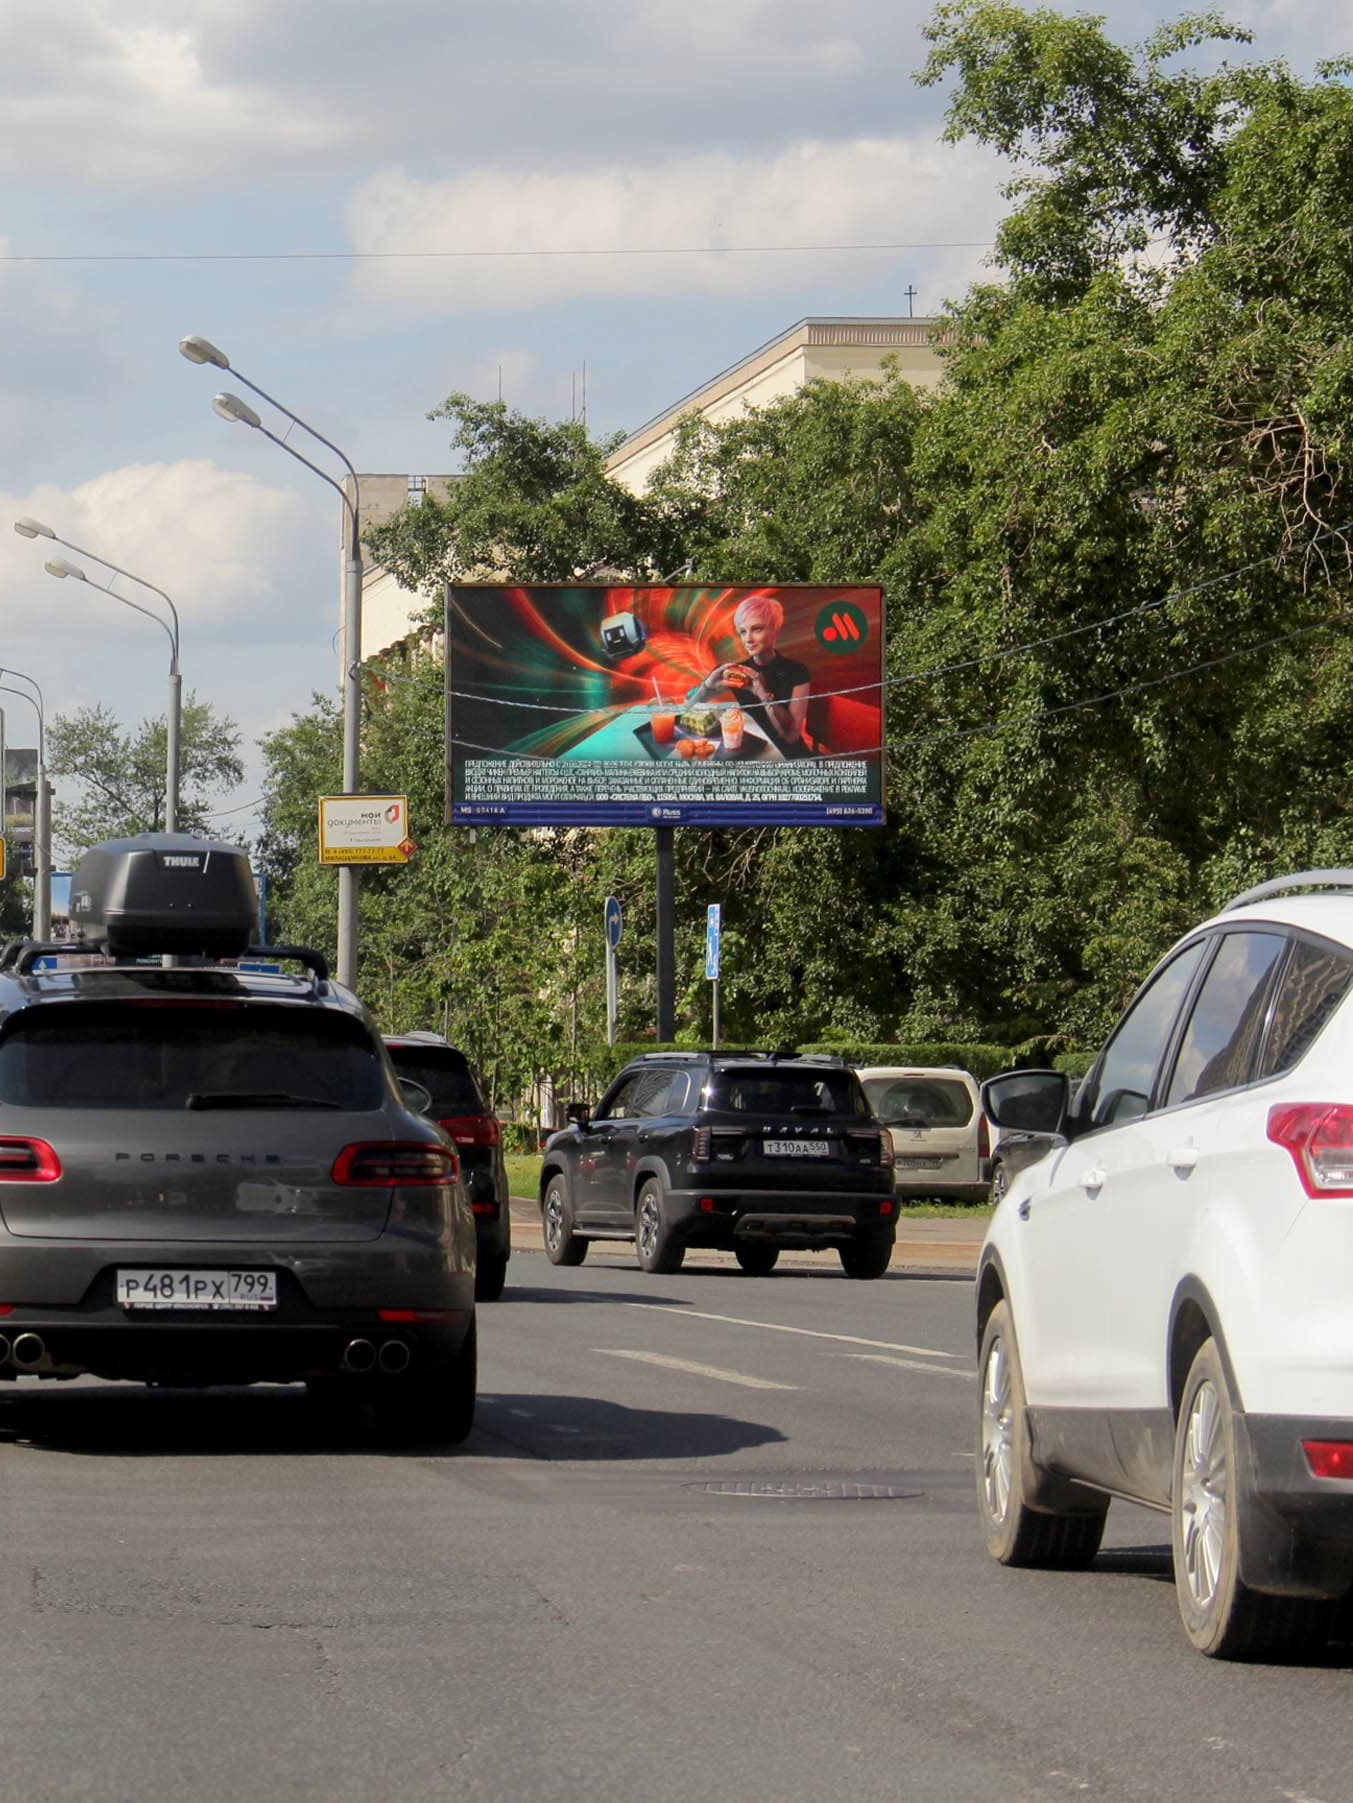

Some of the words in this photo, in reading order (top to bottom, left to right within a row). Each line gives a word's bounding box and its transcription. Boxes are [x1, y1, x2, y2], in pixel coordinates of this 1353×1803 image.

[163, 856, 200, 867] THULE
[762, 1126, 834, 1134] HAVAL
[115, 1152, 281, 1163] PORSCHE
[231, 1273, 269, 1293] 799
